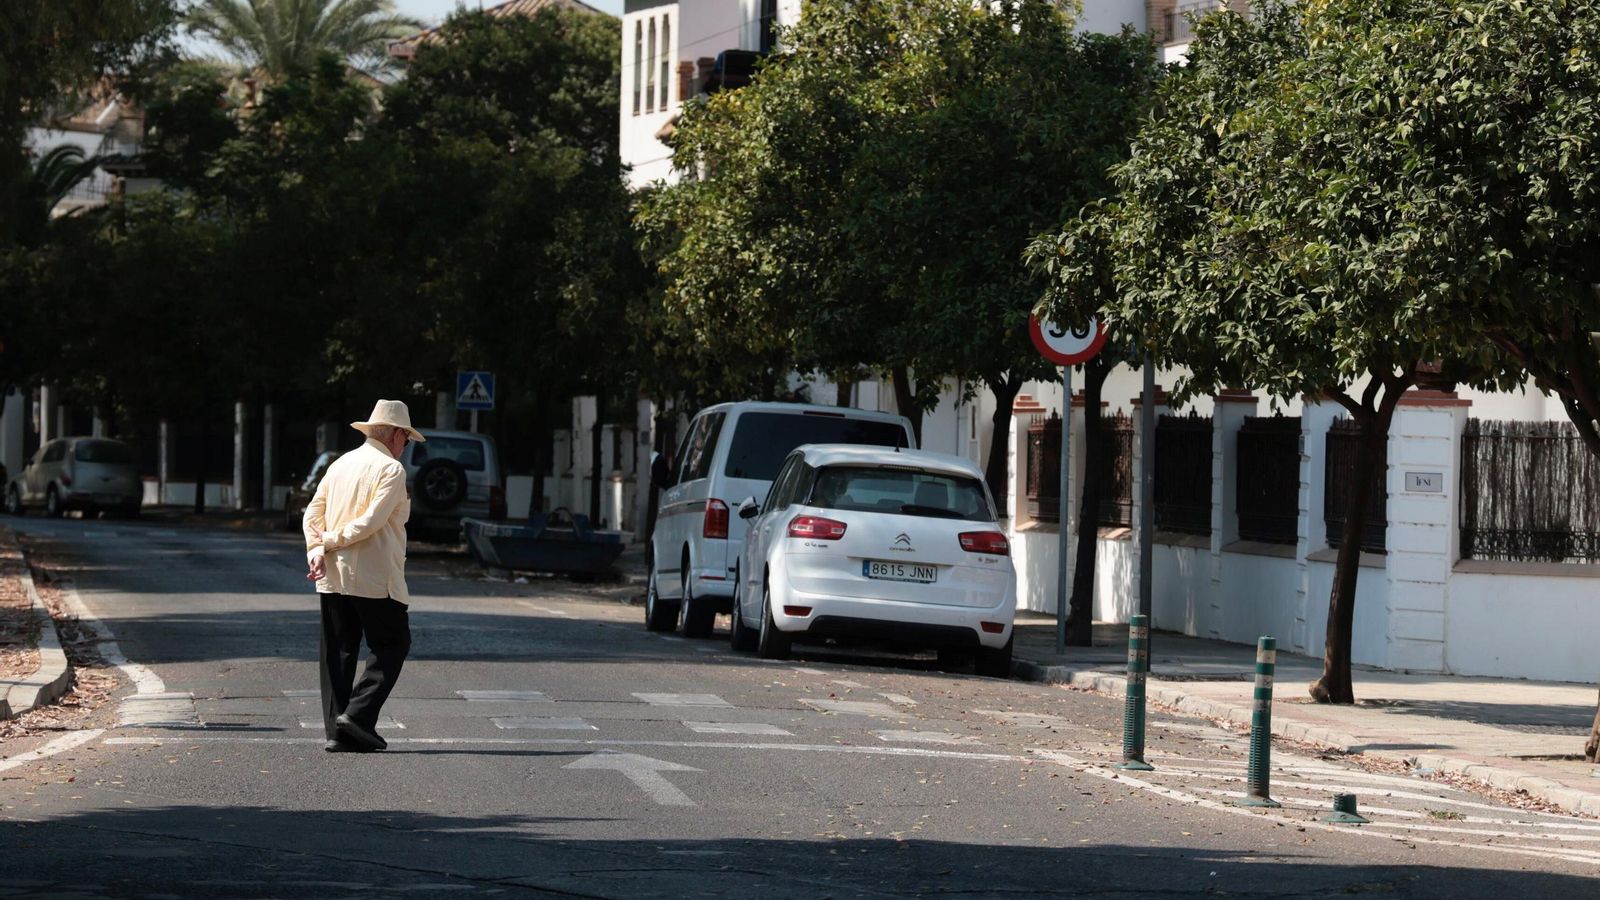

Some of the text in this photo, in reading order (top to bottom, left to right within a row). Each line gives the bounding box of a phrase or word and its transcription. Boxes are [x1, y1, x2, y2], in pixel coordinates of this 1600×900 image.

[1049, 320, 1090, 339] 0
[872, 563, 934, 579] 8615 JNN
